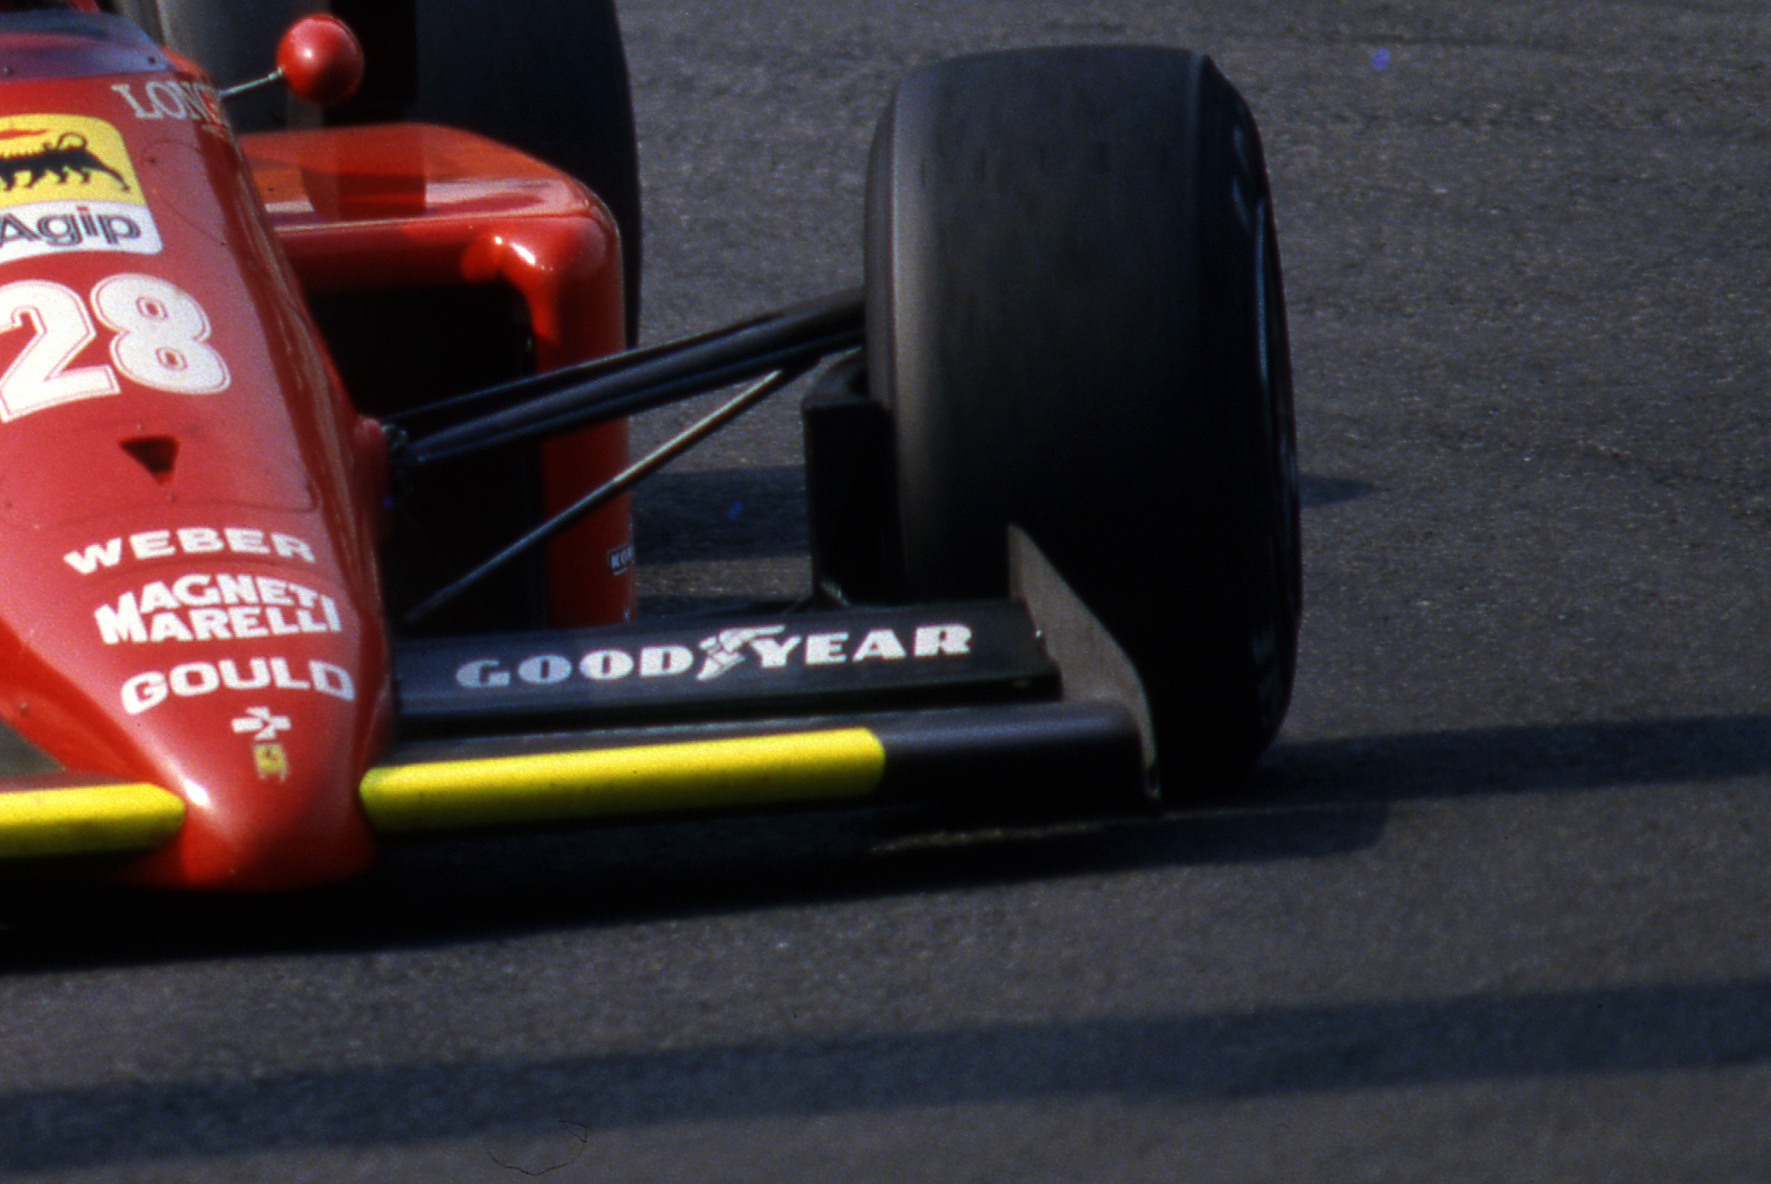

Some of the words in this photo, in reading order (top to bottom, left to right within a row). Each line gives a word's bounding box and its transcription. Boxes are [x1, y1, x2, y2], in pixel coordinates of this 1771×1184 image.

[64, 527, 315, 575] WEBER
[94, 573, 342, 633] MAGNETI
[94, 591, 342, 644] MARELLI
[456, 623, 972, 690] GOODYEAR
[121, 657, 355, 715] GOULD
